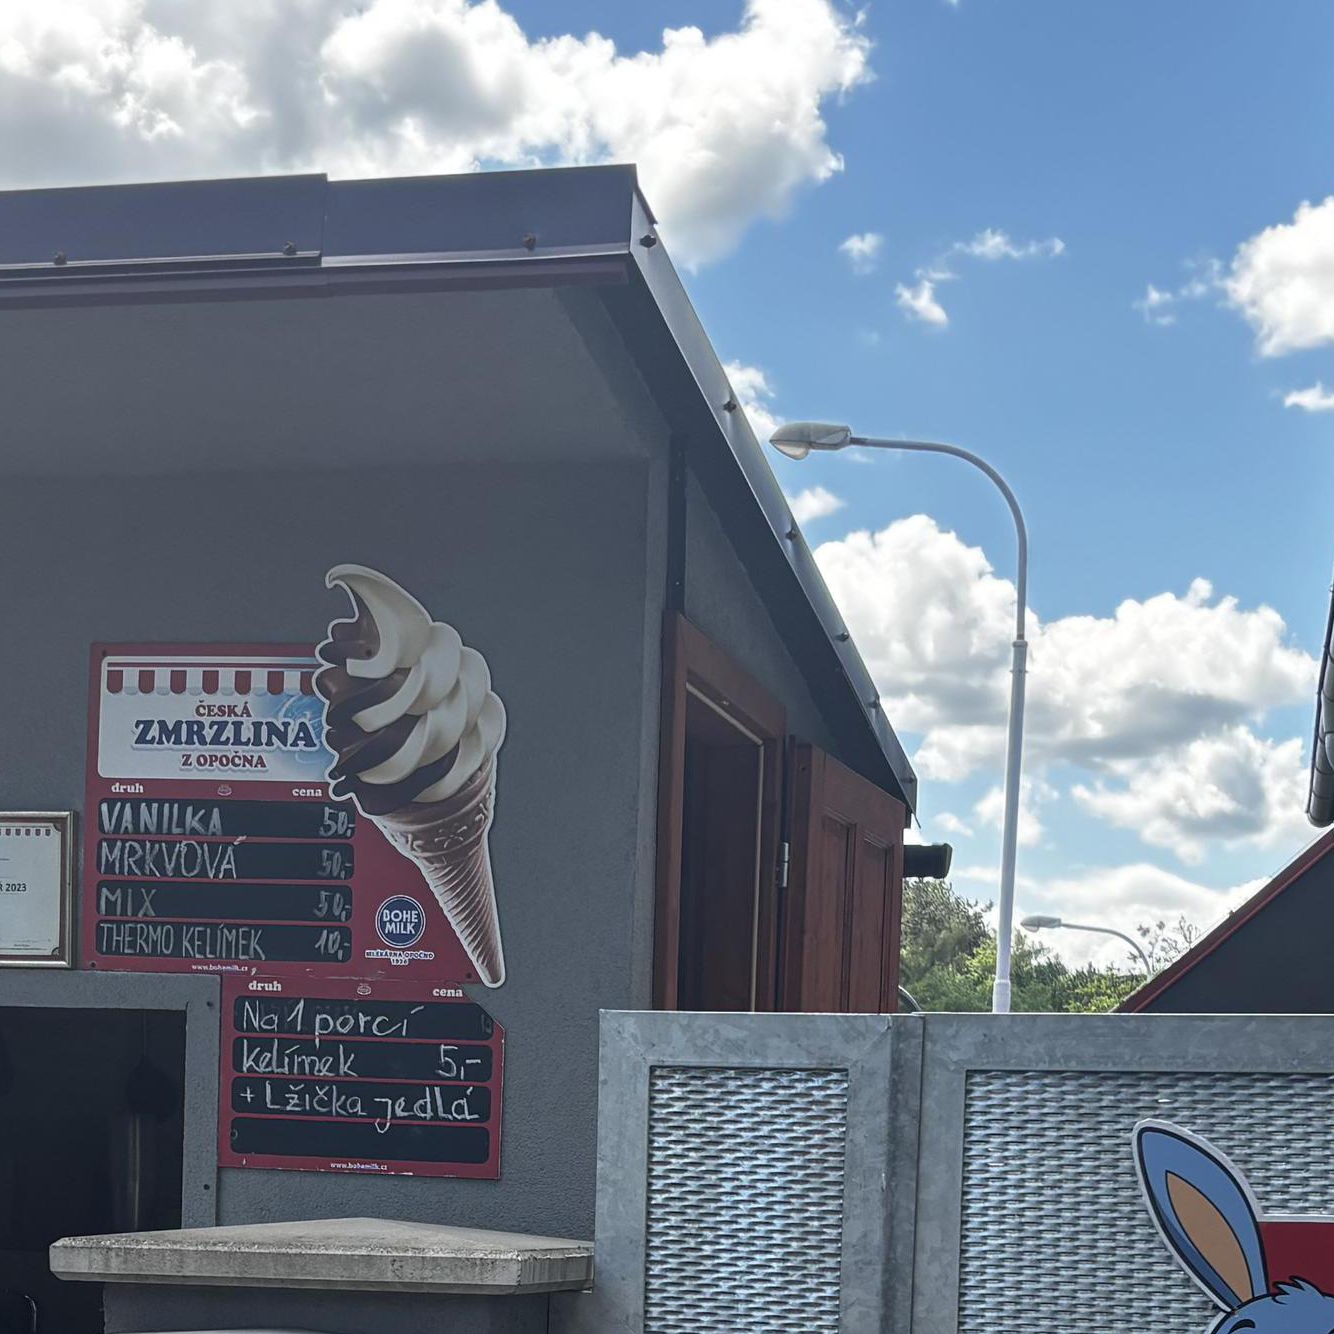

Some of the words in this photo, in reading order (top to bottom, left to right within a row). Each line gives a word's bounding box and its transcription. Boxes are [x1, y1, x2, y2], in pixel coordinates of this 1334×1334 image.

[195, 700, 252, 717] ČESKÁ
[134, 719, 318, 748] ZMRZLINA
[181, 754, 193, 767] Z
[196, 751, 267, 768] OPOČNA
[111, 783, 144, 793] druh
[292, 787, 323, 797] cena
[100, 802, 223, 836] VANILKA
[100, 835, 247, 879] MRKVOVÁ
[5, 882, 27, 892] 2023
[100, 887, 157, 917] MIX
[382, 911, 419, 923] BOHE
[385, 922, 416, 935] MILK
[100, 923, 174, 955] THERMO
[182, 922, 266, 960] KELÍMEK
[248, 981, 282, 992] druh
[432, 988, 463, 998] cena
[243, 1001, 278, 1033] Na
[287, 998, 305, 1031] 1
[315, 1004, 425, 1049] porcí
[239, 1086, 255, 1103] +
